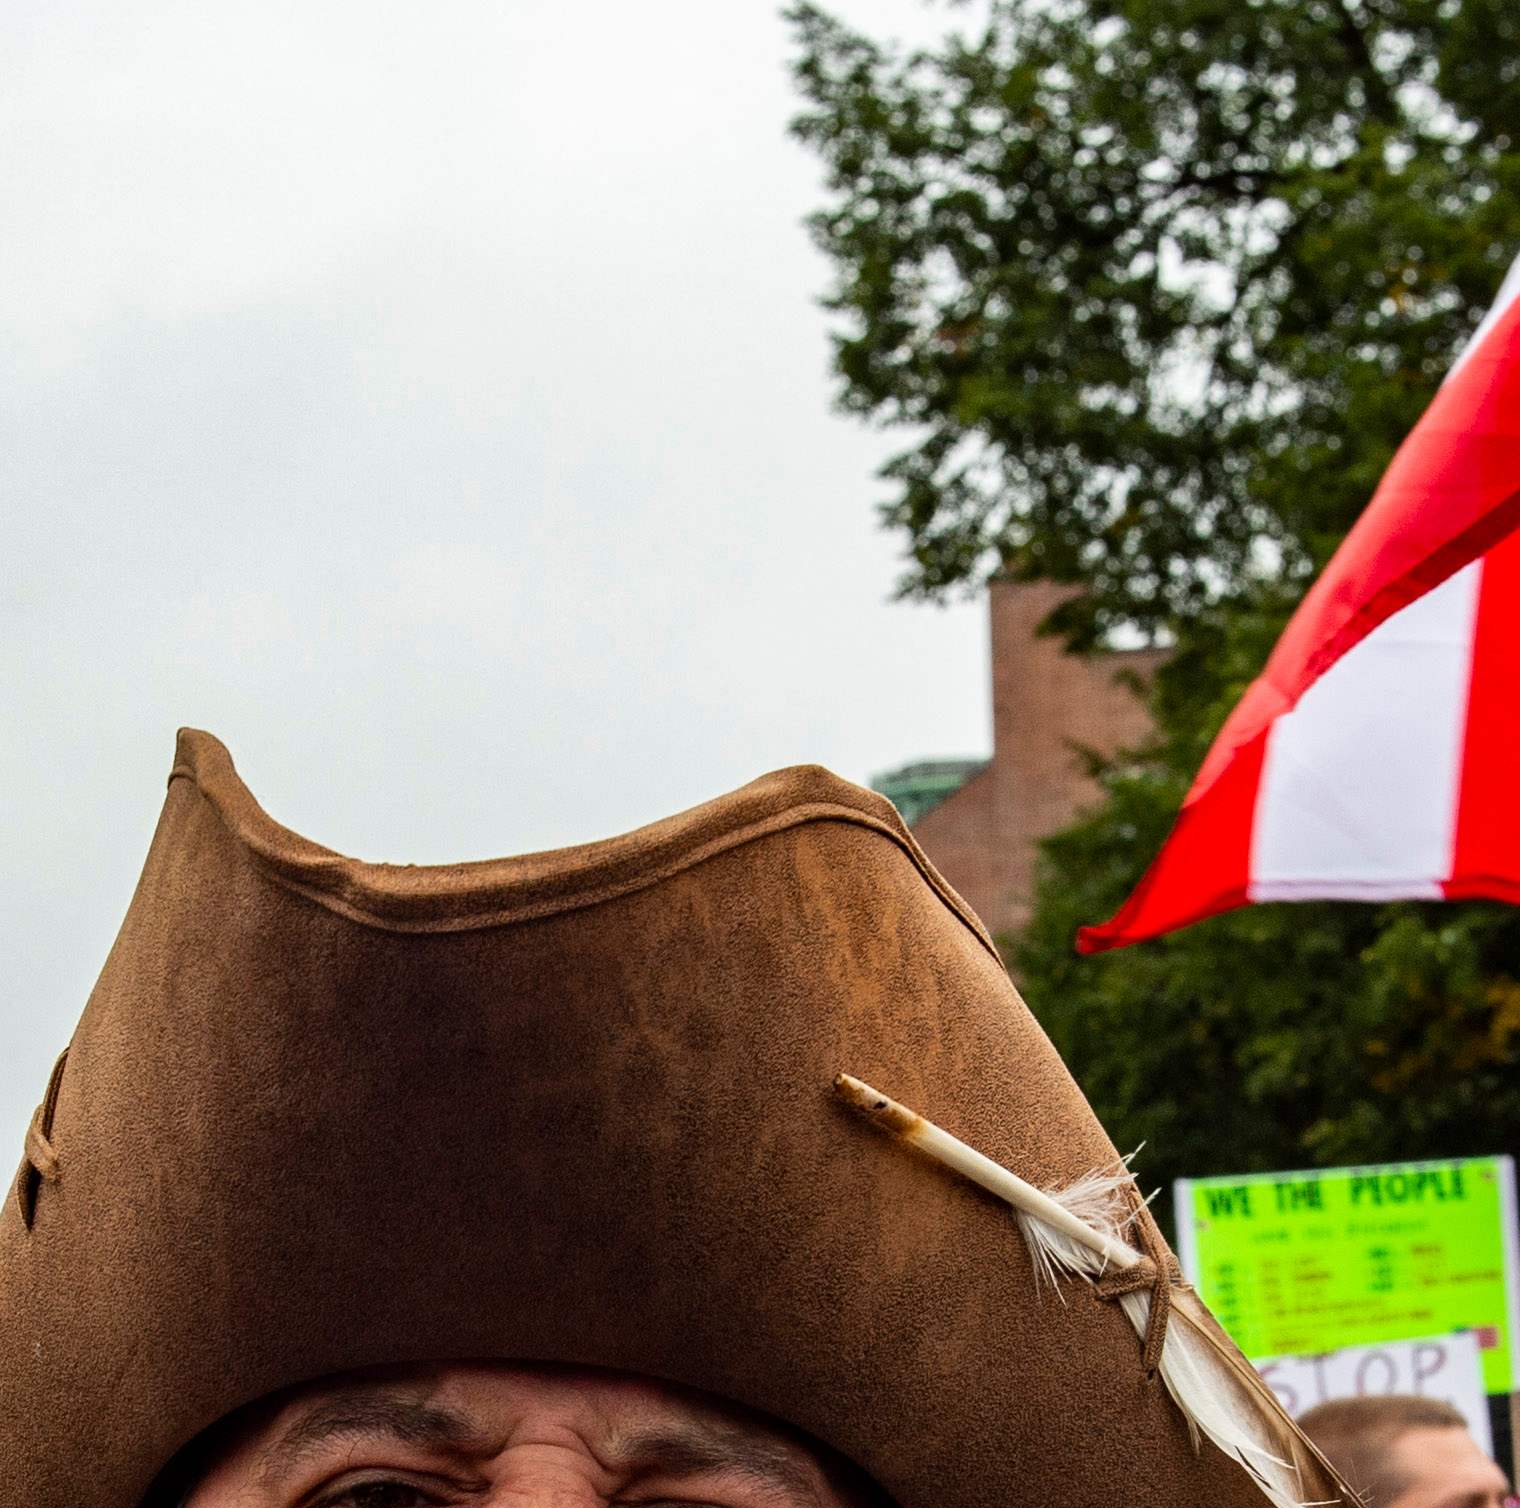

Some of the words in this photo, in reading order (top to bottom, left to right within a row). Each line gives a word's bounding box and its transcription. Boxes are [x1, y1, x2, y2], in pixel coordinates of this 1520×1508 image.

[1205, 1185, 1254, 1218] WE
[1273, 1173, 1326, 1212] THE
[1346, 1163, 1468, 1207] PEOPLE
